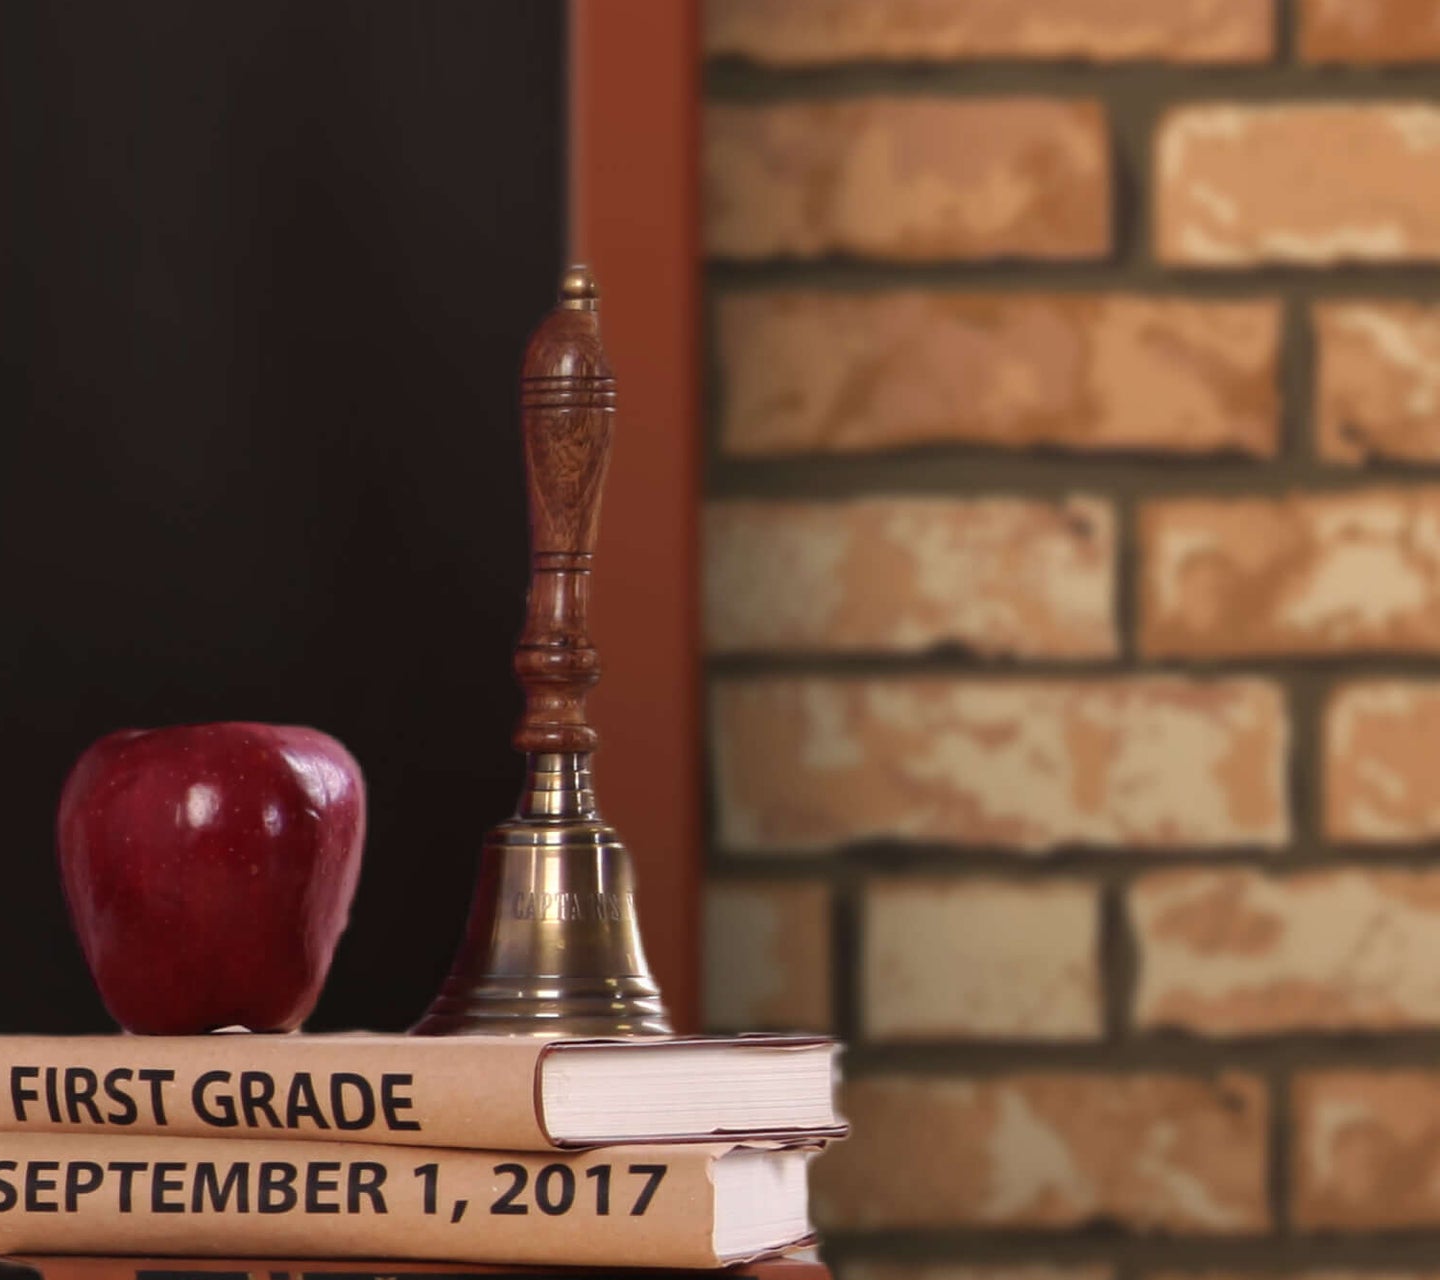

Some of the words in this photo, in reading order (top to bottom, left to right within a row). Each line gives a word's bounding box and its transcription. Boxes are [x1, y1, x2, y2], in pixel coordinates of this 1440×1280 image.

[11, 1066, 175, 1128] FIRST
[191, 1070, 423, 1132] GRADE
[413, 1163, 470, 1224] 1,
[489, 1164, 668, 1217] 2017
